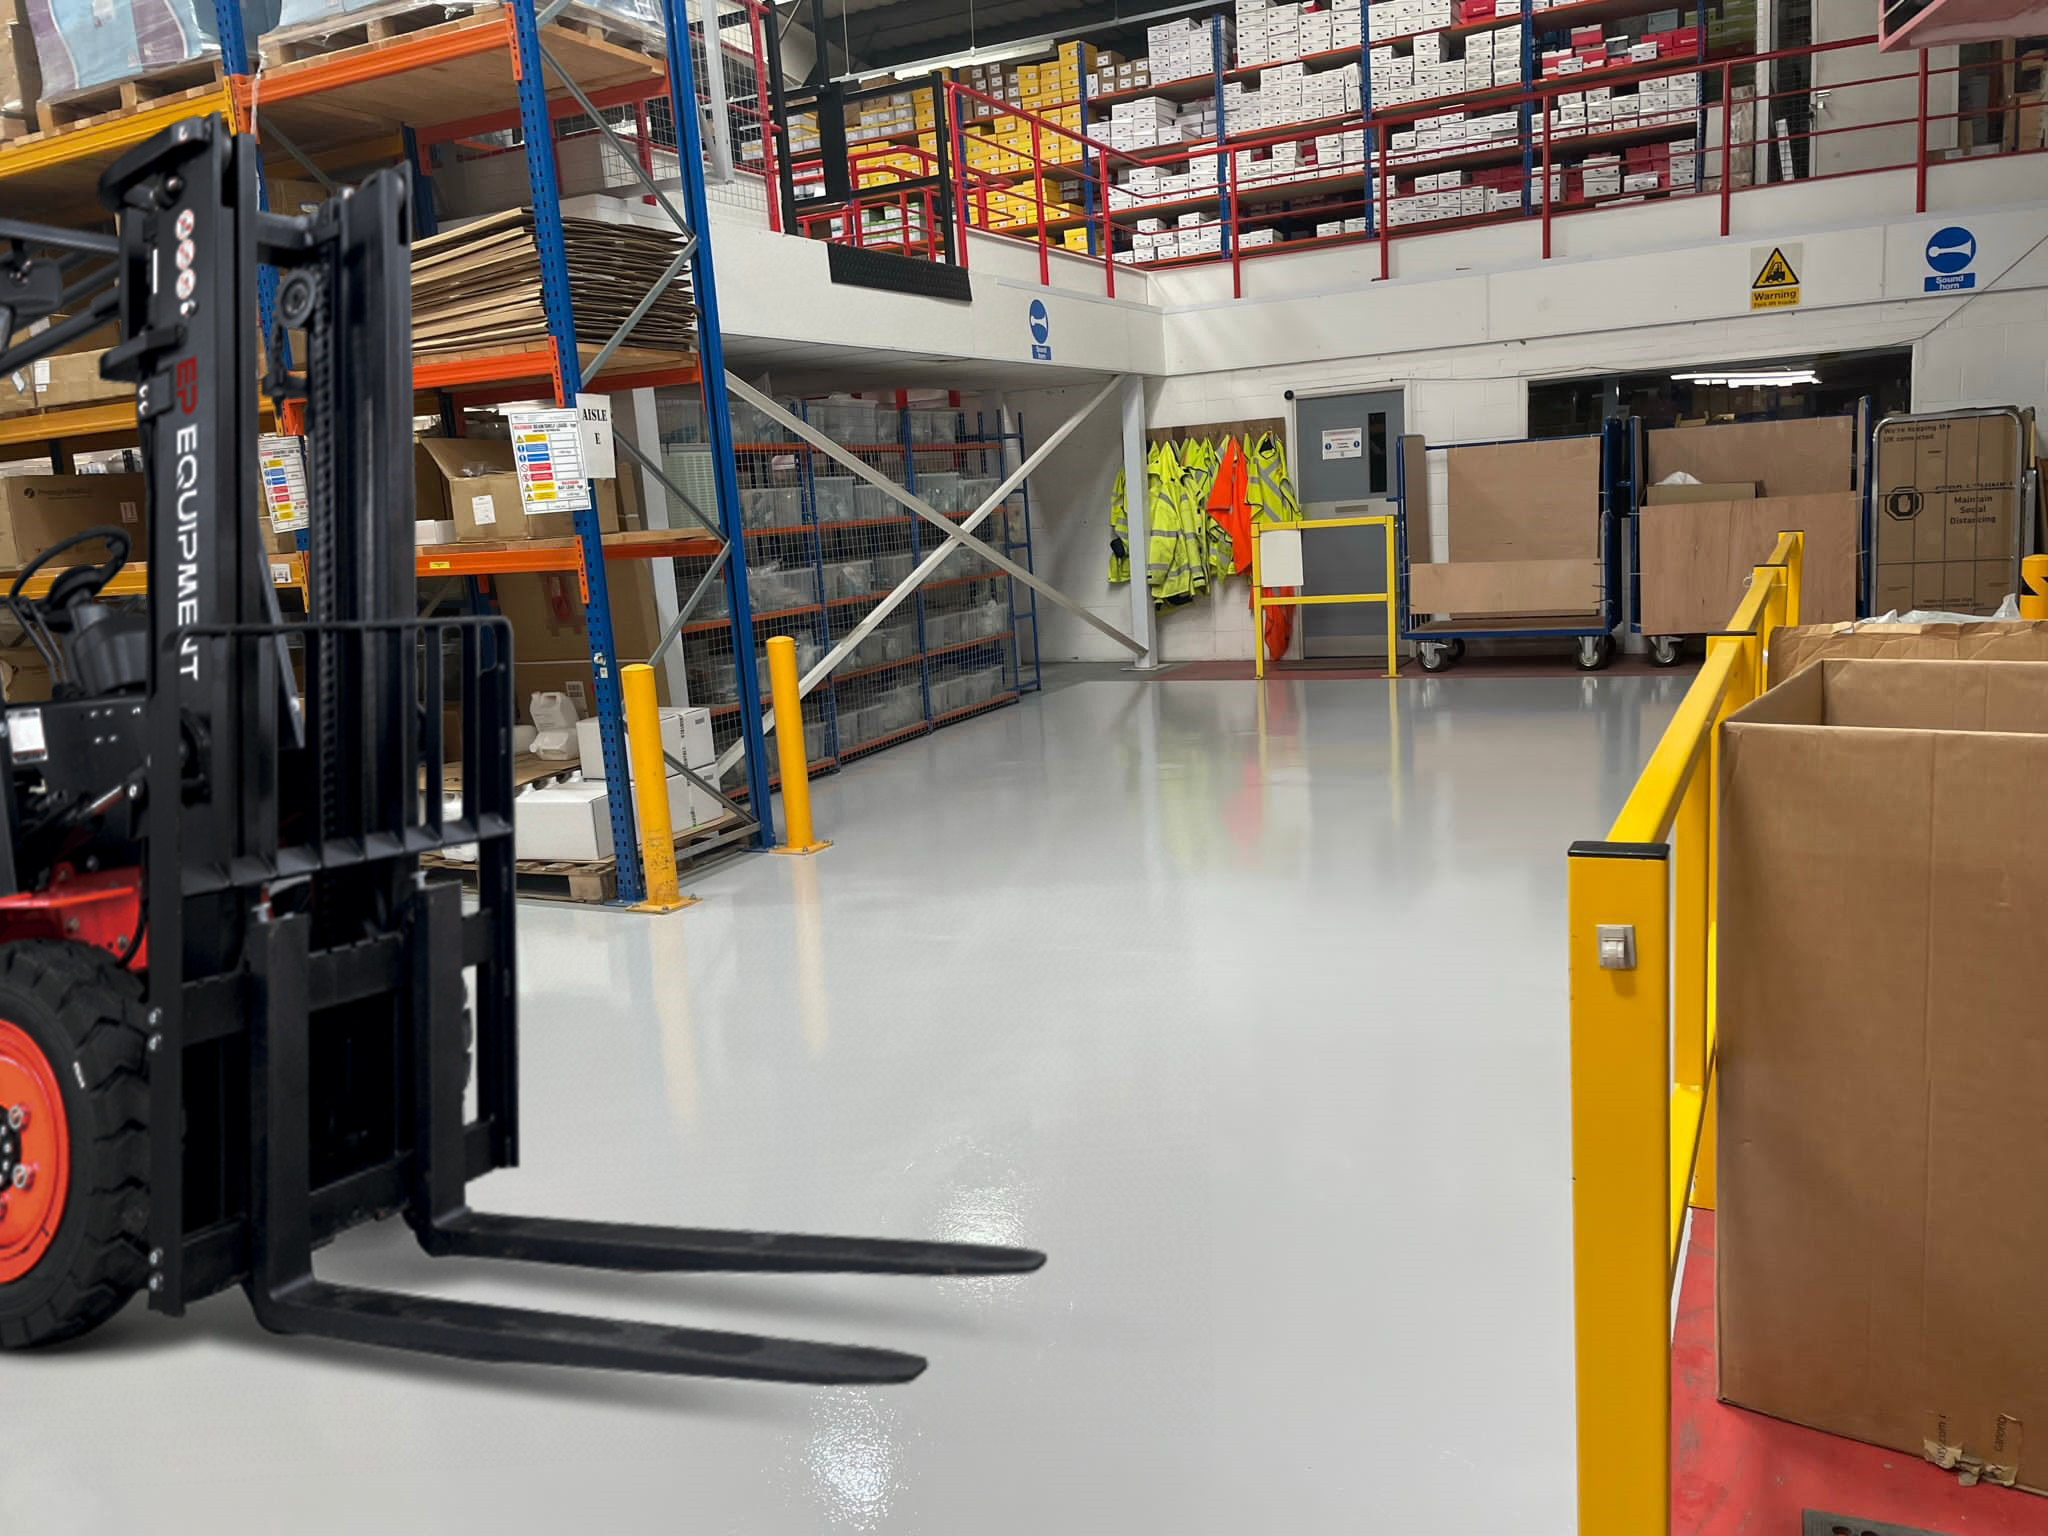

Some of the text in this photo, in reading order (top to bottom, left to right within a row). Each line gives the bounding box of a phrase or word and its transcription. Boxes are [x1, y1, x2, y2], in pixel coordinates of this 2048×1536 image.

[1935, 275, 1964, 284] Sound
[1939, 282, 1960, 290] horn
[1753, 291, 1797, 301] Warning
[176, 355, 197, 416] EP
[582, 408, 608, 422] AISLE
[594, 432, 601, 445] E
[1954, 495, 1993, 503] Maintain
[1950, 516, 1996, 525] Distancing
